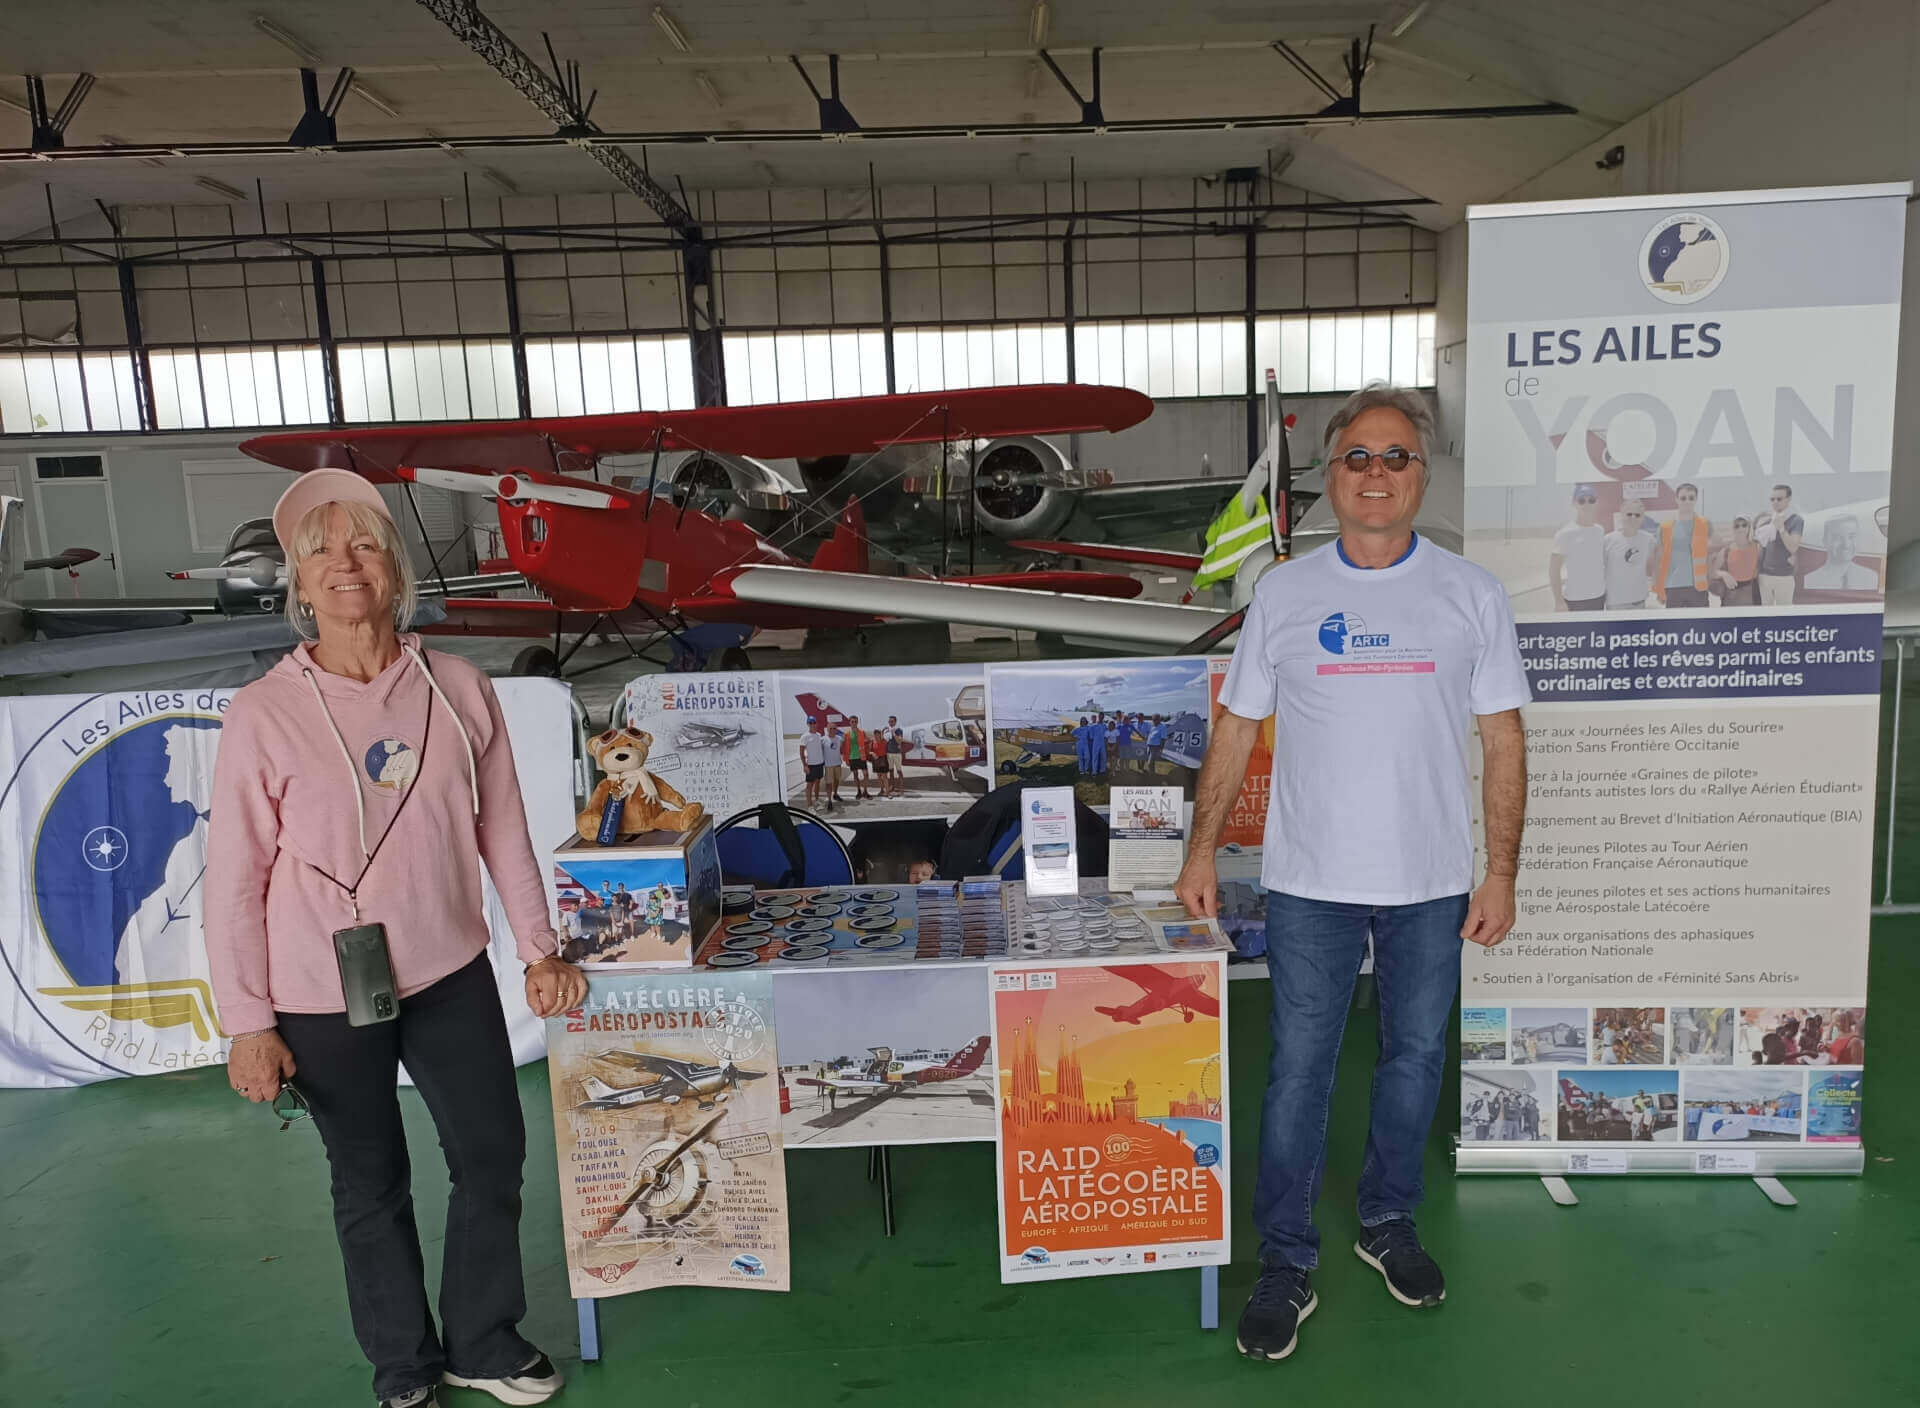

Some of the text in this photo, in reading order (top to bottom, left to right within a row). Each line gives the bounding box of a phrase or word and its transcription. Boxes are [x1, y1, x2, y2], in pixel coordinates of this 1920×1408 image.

[1507, 322, 1721, 367] LES AILES
[1505, 371, 1539, 397] de
[1508, 384, 1855, 485] YOAN
[1354, 636, 1388, 646] ARTC
[1519, 625, 1838, 651] artager la passion du vol et susciter
[1522, 646, 1875, 670] ousiasme et les rêves parmi les enfants
[1537, 670, 1803, 691] ordinaires et extraordinaires
[62, 688, 231, 756] Les Ailes de
[1552, 728, 1575, 736] aux
[1580, 725, 1644, 736] «Journées
[1649, 723, 1666, 735] les
[1670, 723, 1703, 735] Ailes
[1708, 723, 1724, 734] du
[1729, 721, 1784, 734] Sourire»
[1525, 738, 1739, 753] viation Sans Frontière Occitanie
[1551, 771, 1558, 782] à
[1563, 770, 1573, 781] la
[1577, 770, 1627, 783] journée
[1632, 768, 1688, 780] «Graines
[1693, 768, 1710, 779] de
[1714, 768, 1758, 781] pilote»
[1531, 779, 1863, 798] d'enfants autistes lors du «Rallye Aérien Étudiant»
[1123, 798, 1172, 812] YOAN
[1526, 810, 1862, 828] pagnement au Brevet d'Initiation Aéronautique (BIA)
[1538, 843, 1553, 853] de
[1557, 843, 1600, 856] jeunes
[1604, 841, 1647, 853] Pilotes
[1651, 843, 1667, 852] au
[1672, 841, 1700, 852] Tour
[1704, 841, 1748, 852] Aérien
[1593, 858, 1653, 872] Française
[1656, 857, 1749, 870] Aéronautique
[1536, 887, 1553, 897] de
[1557, 887, 1599, 900] jeunes
[1603, 886, 1645, 899] pilotes
[1650, 887, 1662, 896] et
[1668, 888, 1688, 896] ses
[1692, 885, 1740, 896] actions
[1745, 884, 1831, 896] humanitaires
[1521, 901, 1710, 915] ligne Aérospostale Latécoère
[1504, 929, 1754, 943] tien aux organisations des aphasiques
[1483, 944, 1654, 956] et sa Fédération Nationale
[1483, 971, 1800, 986] Soutien à l'organisation de «Féminité Sans Abris»
[589, 984, 725, 1010] LATÉCOÈRE
[715, 1021, 753, 1040] 2020
[84, 1015, 228, 1068] Raid Latéc
[577, 1138, 618, 1149] TOULOUSE
[1105, 1141, 1130, 1155] 100
[571, 1148, 626, 1162] CASABLANCA
[1017, 1146, 1100, 1173] RAID
[580, 1161, 619, 1172] TARFAYA
[575, 1171, 626, 1184] NOUADHIBOU
[1018, 1165, 1208, 1202] LATÉCOÈRE
[586, 1194, 620, 1205] DAKHLA
[1021, 1193, 1208, 1225] AÉROPOSTALE
[1021, 1217, 1208, 1238] EUROPE AFRIQUE AMÉRIQUE DU SUD
